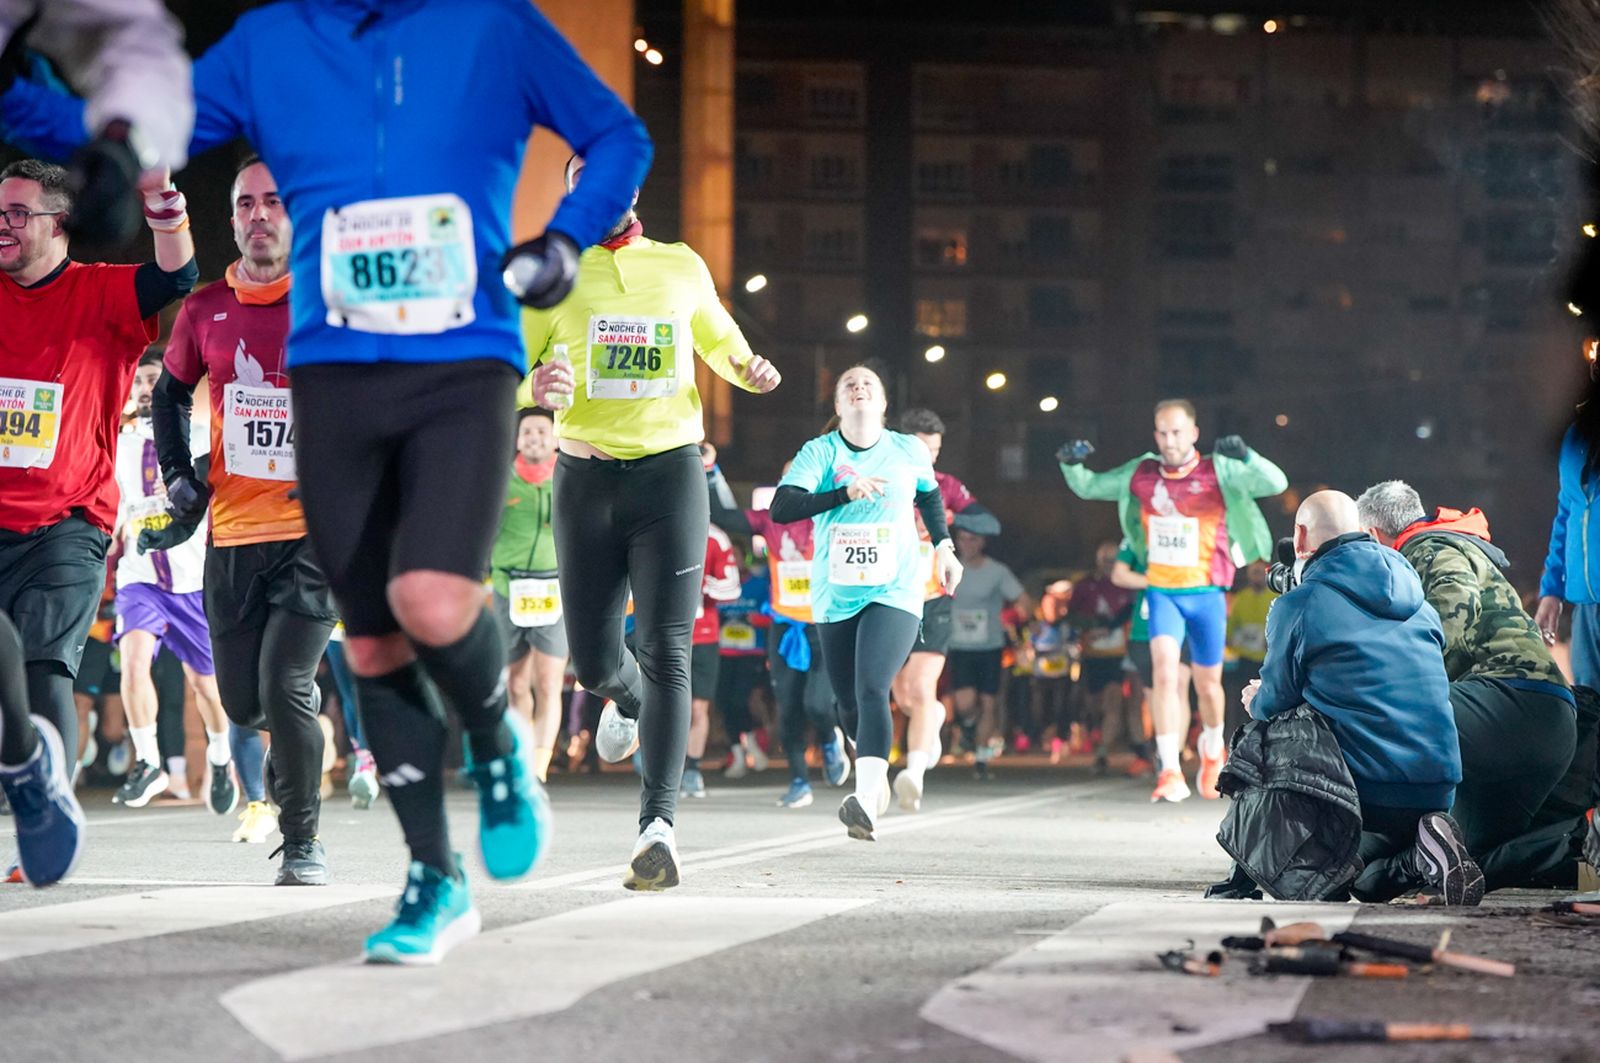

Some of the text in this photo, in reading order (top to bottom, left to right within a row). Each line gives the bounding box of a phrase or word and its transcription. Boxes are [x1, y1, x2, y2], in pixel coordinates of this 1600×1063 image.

[350, 247, 446, 290] 8623
[609, 324, 635, 334] NOCHE
[637, 325, 648, 334] DE
[597, 334, 616, 344] SAN
[606, 345, 662, 372] 7246
[15, 389, 26, 398] DE
[244, 397, 274, 408] NOCHE
[276, 399, 288, 408] DE
[234, 406, 288, 419] SAN ANTÓN
[268, 449, 294, 458] CARLOS
[844, 546, 879, 564] 255
